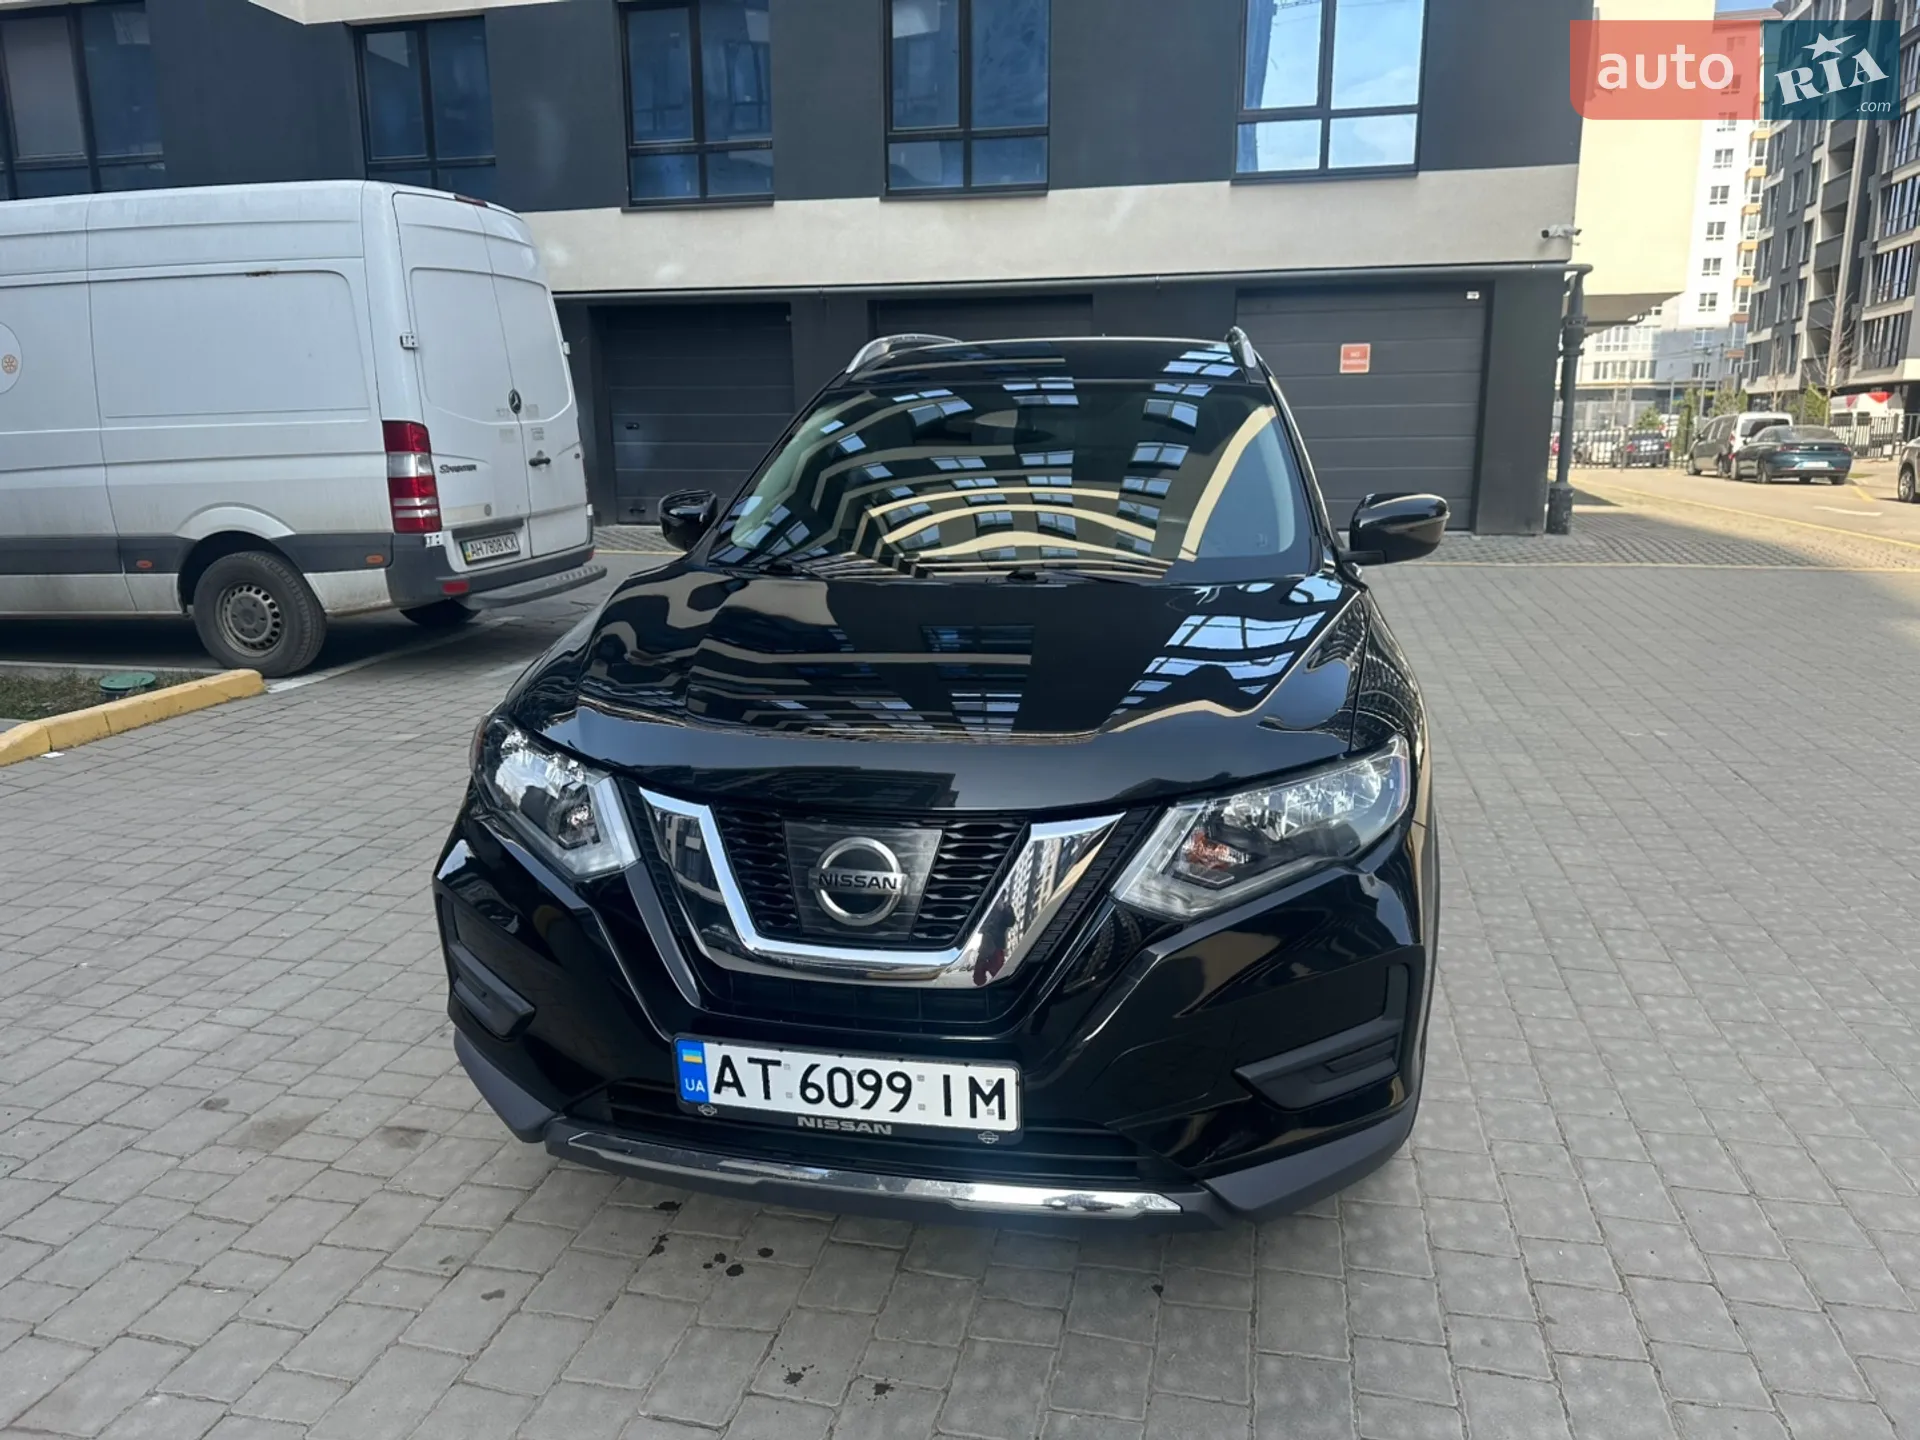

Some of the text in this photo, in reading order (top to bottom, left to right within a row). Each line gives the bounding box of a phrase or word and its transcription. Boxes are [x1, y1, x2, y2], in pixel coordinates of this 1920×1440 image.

[818, 873, 898, 890] NISSAN
[685, 1077, 705, 1092] UA
[713, 1055, 1006, 1121] AT 6099 IM
[797, 1115, 892, 1135] NISSAN
